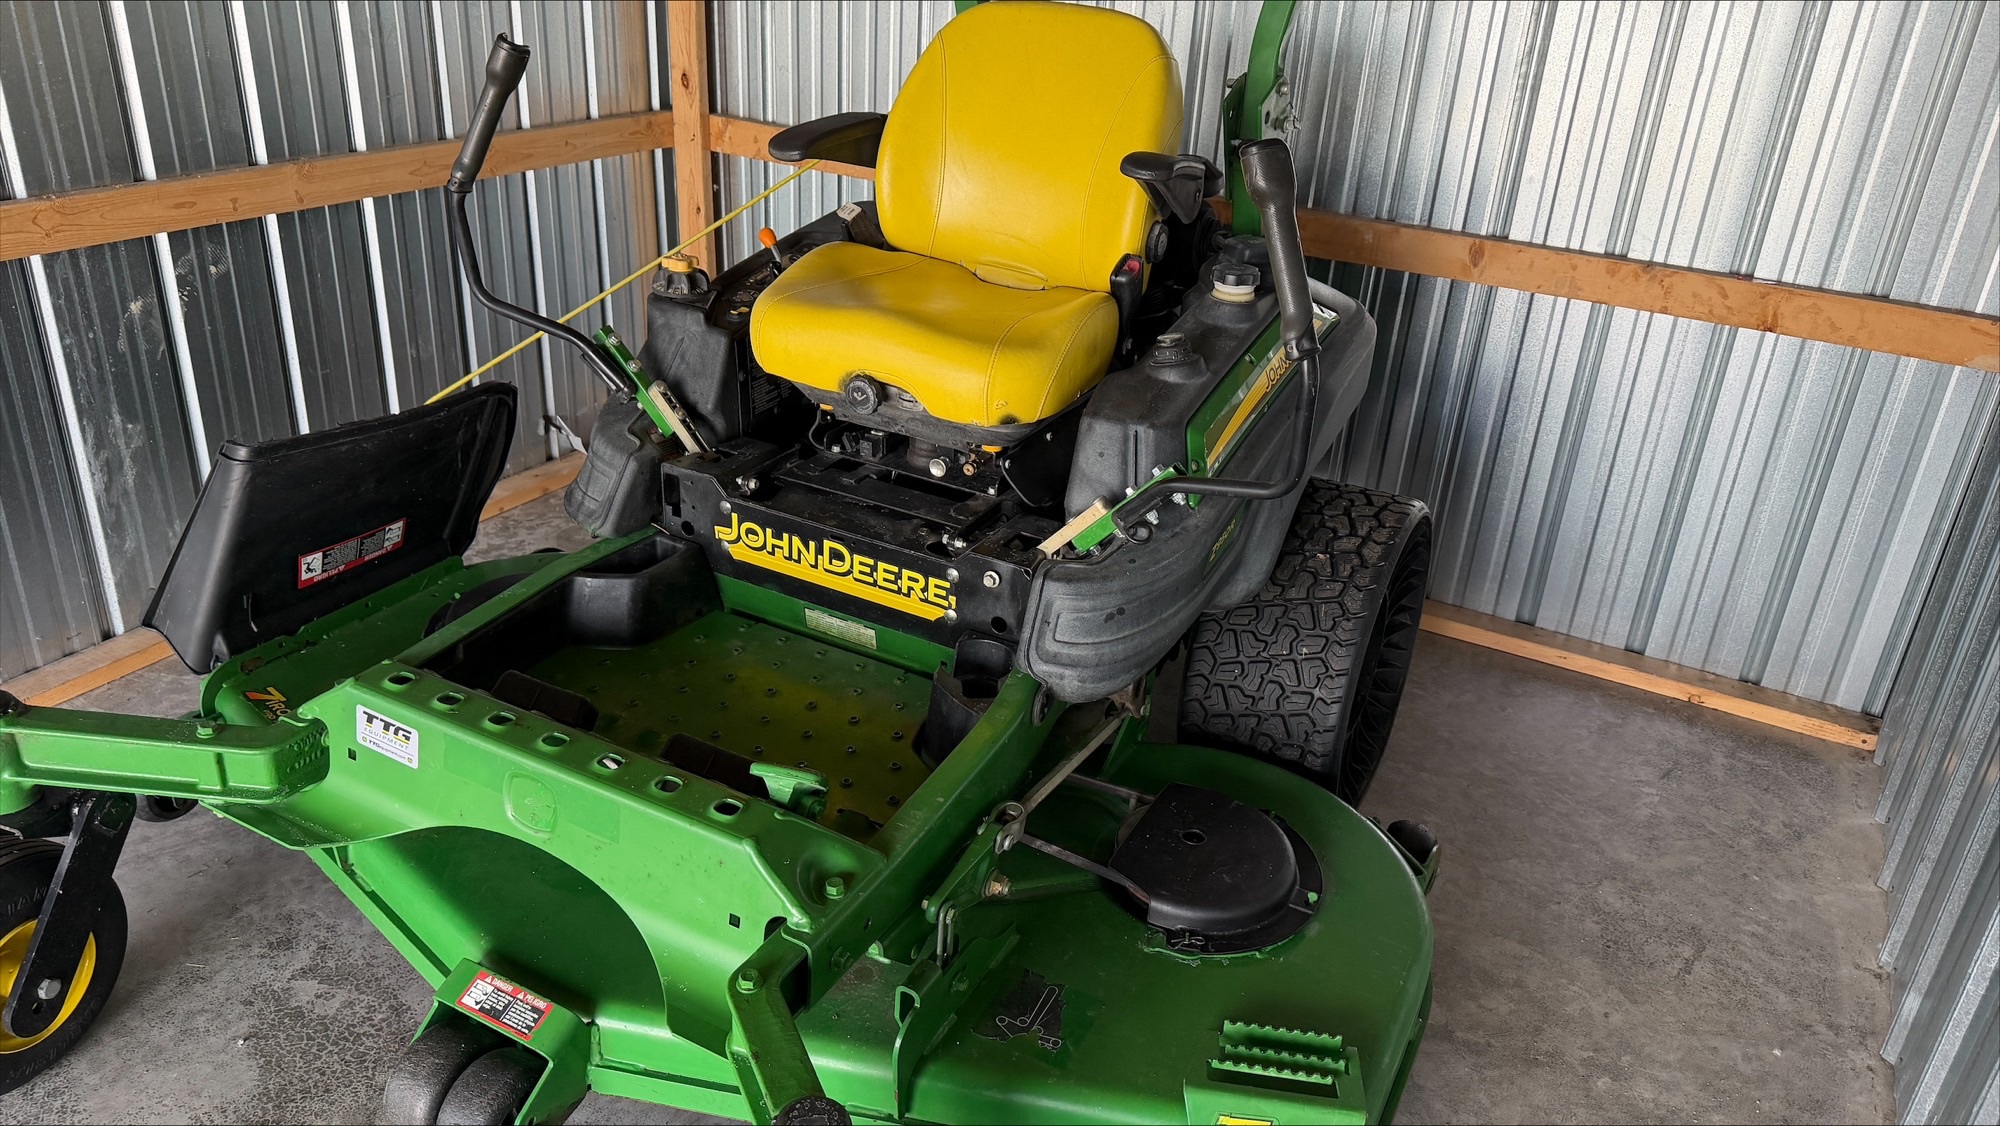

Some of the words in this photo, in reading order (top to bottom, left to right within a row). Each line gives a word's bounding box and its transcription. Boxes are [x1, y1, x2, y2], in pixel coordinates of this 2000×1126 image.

[364, 548, 387, 561] DANGER
[714, 512, 817, 566] JOHN
[823, 539, 956, 609] DEERE
[313, 568, 339, 583] PELIGRO
[363, 710, 412, 745] TTG
[363, 726, 409, 751] EQUIPMENT
[491, 977, 514, 993] DANGER
[524, 991, 548, 1009] PELIGRO
